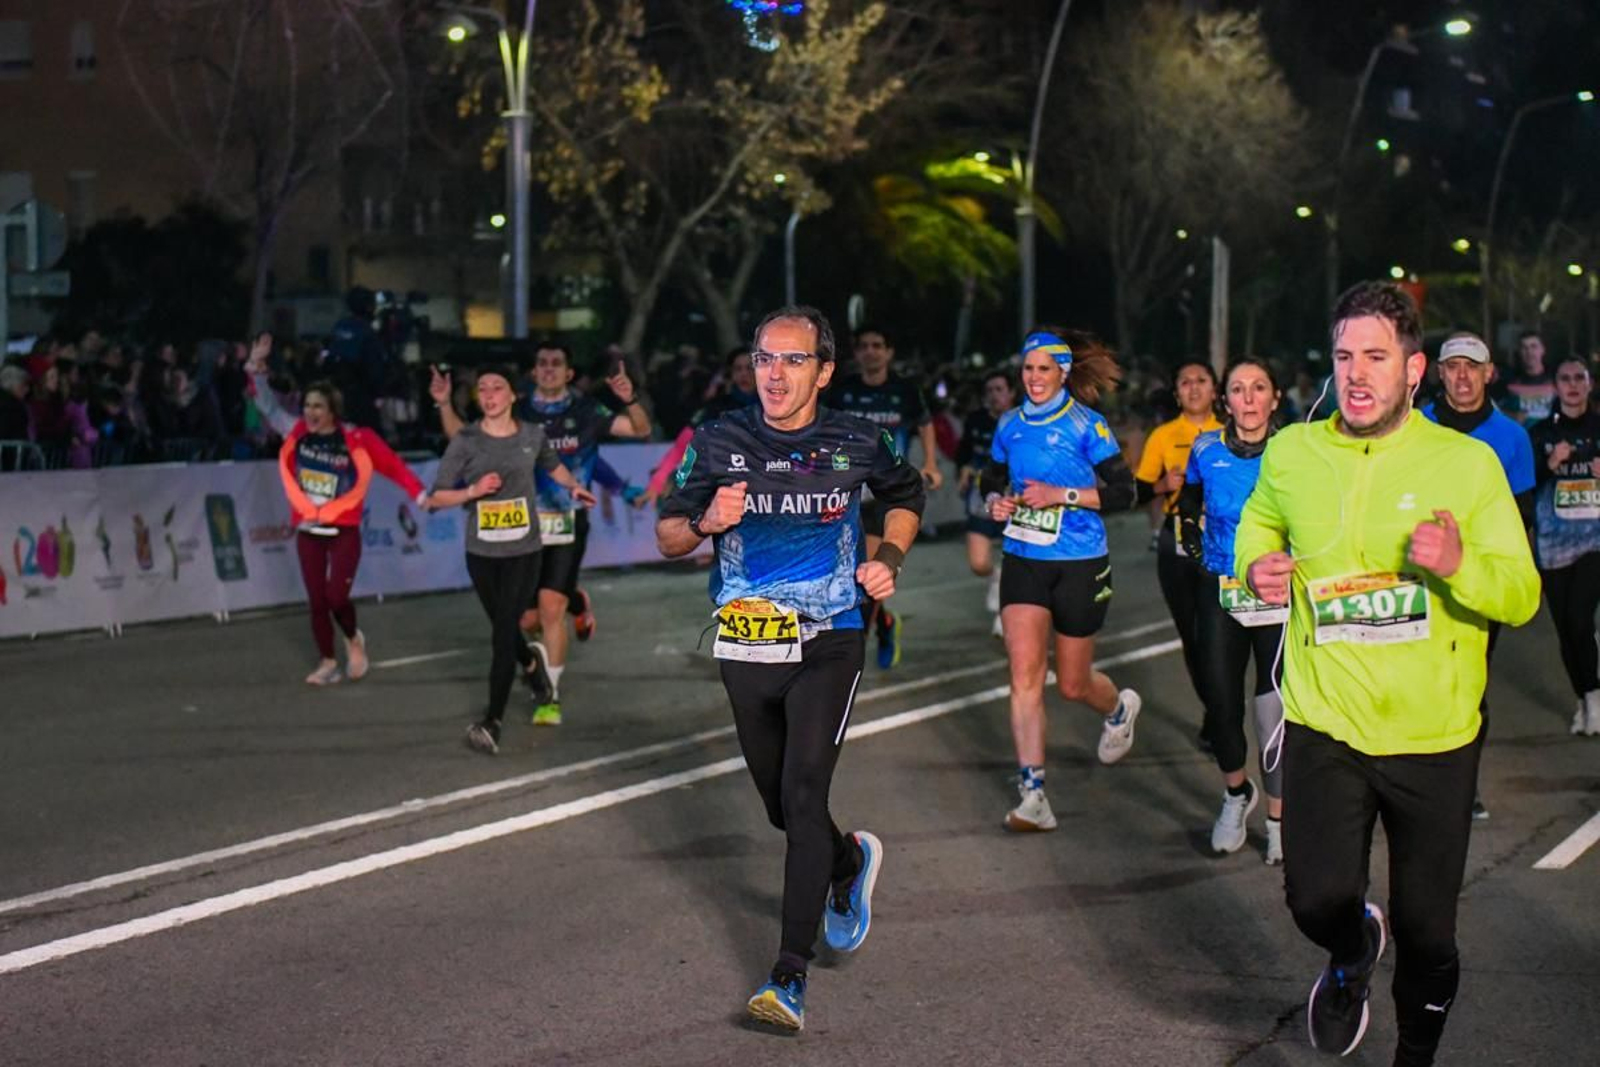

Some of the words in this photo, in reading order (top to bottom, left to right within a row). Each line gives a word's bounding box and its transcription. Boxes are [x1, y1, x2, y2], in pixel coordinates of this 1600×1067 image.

[765, 458, 791, 472] jaén
[743, 493, 773, 514] AN
[780, 487, 850, 514] ANTÓN
[483, 511, 523, 526] 3740
[1326, 584, 1418, 621] 1307
[726, 614, 789, 638] 4377
